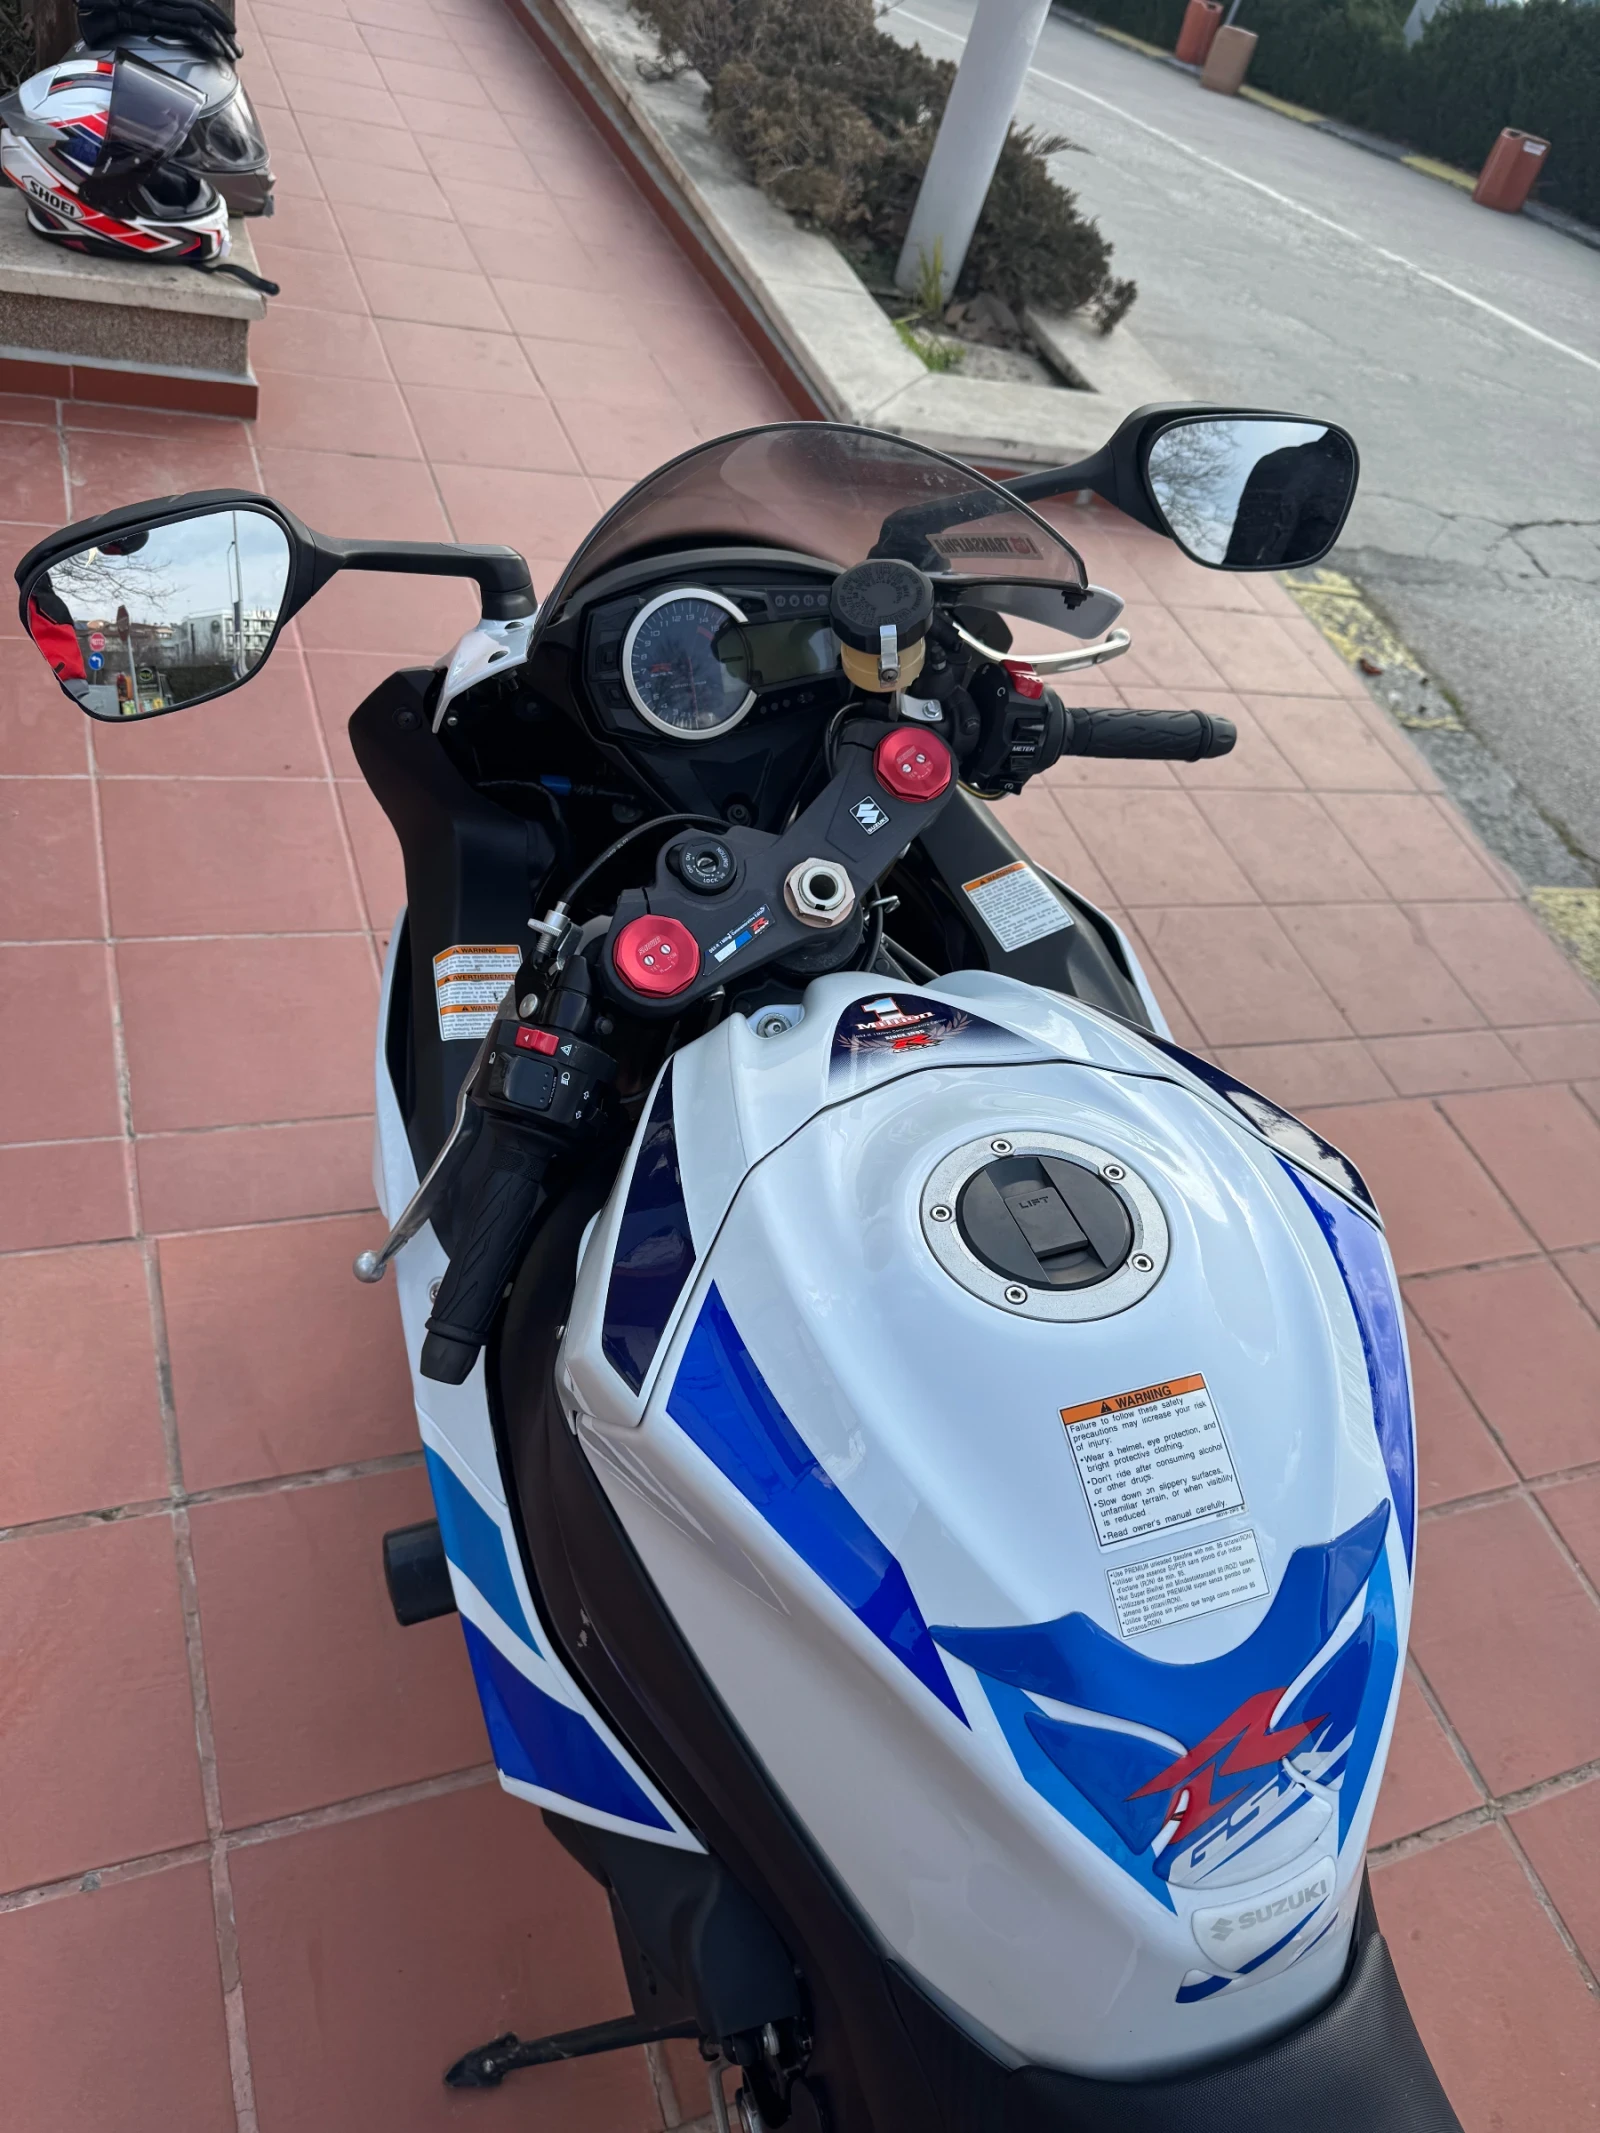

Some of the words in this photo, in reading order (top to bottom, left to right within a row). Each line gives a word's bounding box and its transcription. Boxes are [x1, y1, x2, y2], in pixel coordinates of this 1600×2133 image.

[30, 180, 75, 216] SHOEI
[856, 1011, 935, 1030] Million
[861, 997, 905, 1021] 1
[1018, 1196, 1049, 1209] LIFT
[1115, 1386, 1172, 1408] WARNING
[1070, 1421, 1096, 1433] Failure
[1112, 1411, 1134, 1421] follow
[1138, 1405, 1158, 1415] these
[1161, 1398, 1183, 1408] safety
[1073, 1426, 1118, 1444] precautions
[1122, 1420, 1137, 1429] may
[1142, 1411, 1171, 1424] increase
[1175, 1406, 1190, 1416] your
[1194, 1401, 1207, 1409] risk
[1084, 1453, 1104, 1463] Wear
[1117, 1442, 1144, 1454] helmet,
[1147, 1438, 1160, 1447] eye
[1164, 1427, 1200, 1443] protection,
[1203, 1421, 1216, 1430] and
[1087, 1461, 1110, 1472] bright
[1114, 1451, 1150, 1467] protective
[1154, 1442, 1184, 1454] clothing.
[1091, 1474, 1112, 1485] Don't
[1116, 1470, 1131, 1478] ride
[1136, 1464, 1151, 1473] after
[1156, 1452, 1195, 1467] consuming
[1199, 1443, 1223, 1455] alcohol
[1098, 1498, 1116, 1508] Slow
[1121, 1491, 1142, 1501] down
[1159, 1478, 1187, 1491] slippery
[1101, 1502, 1137, 1517] unfamiliar
[1142, 1494, 1168, 1506] terrain,
[1184, 1483, 1203, 1493] when
[1207, 1474, 1233, 1486] visibility
[1107, 1481, 1126, 1491] other
[1131, 1474, 1153, 1485] drugs.
[1107, 1528, 1128, 1539] Read
[1132, 1519, 1161, 1533] owner's
[1165, 1509, 1192, 1523] manual
[1125, 1686, 1331, 1844] R
[1238, 1880, 1328, 1930] SUZUKI
